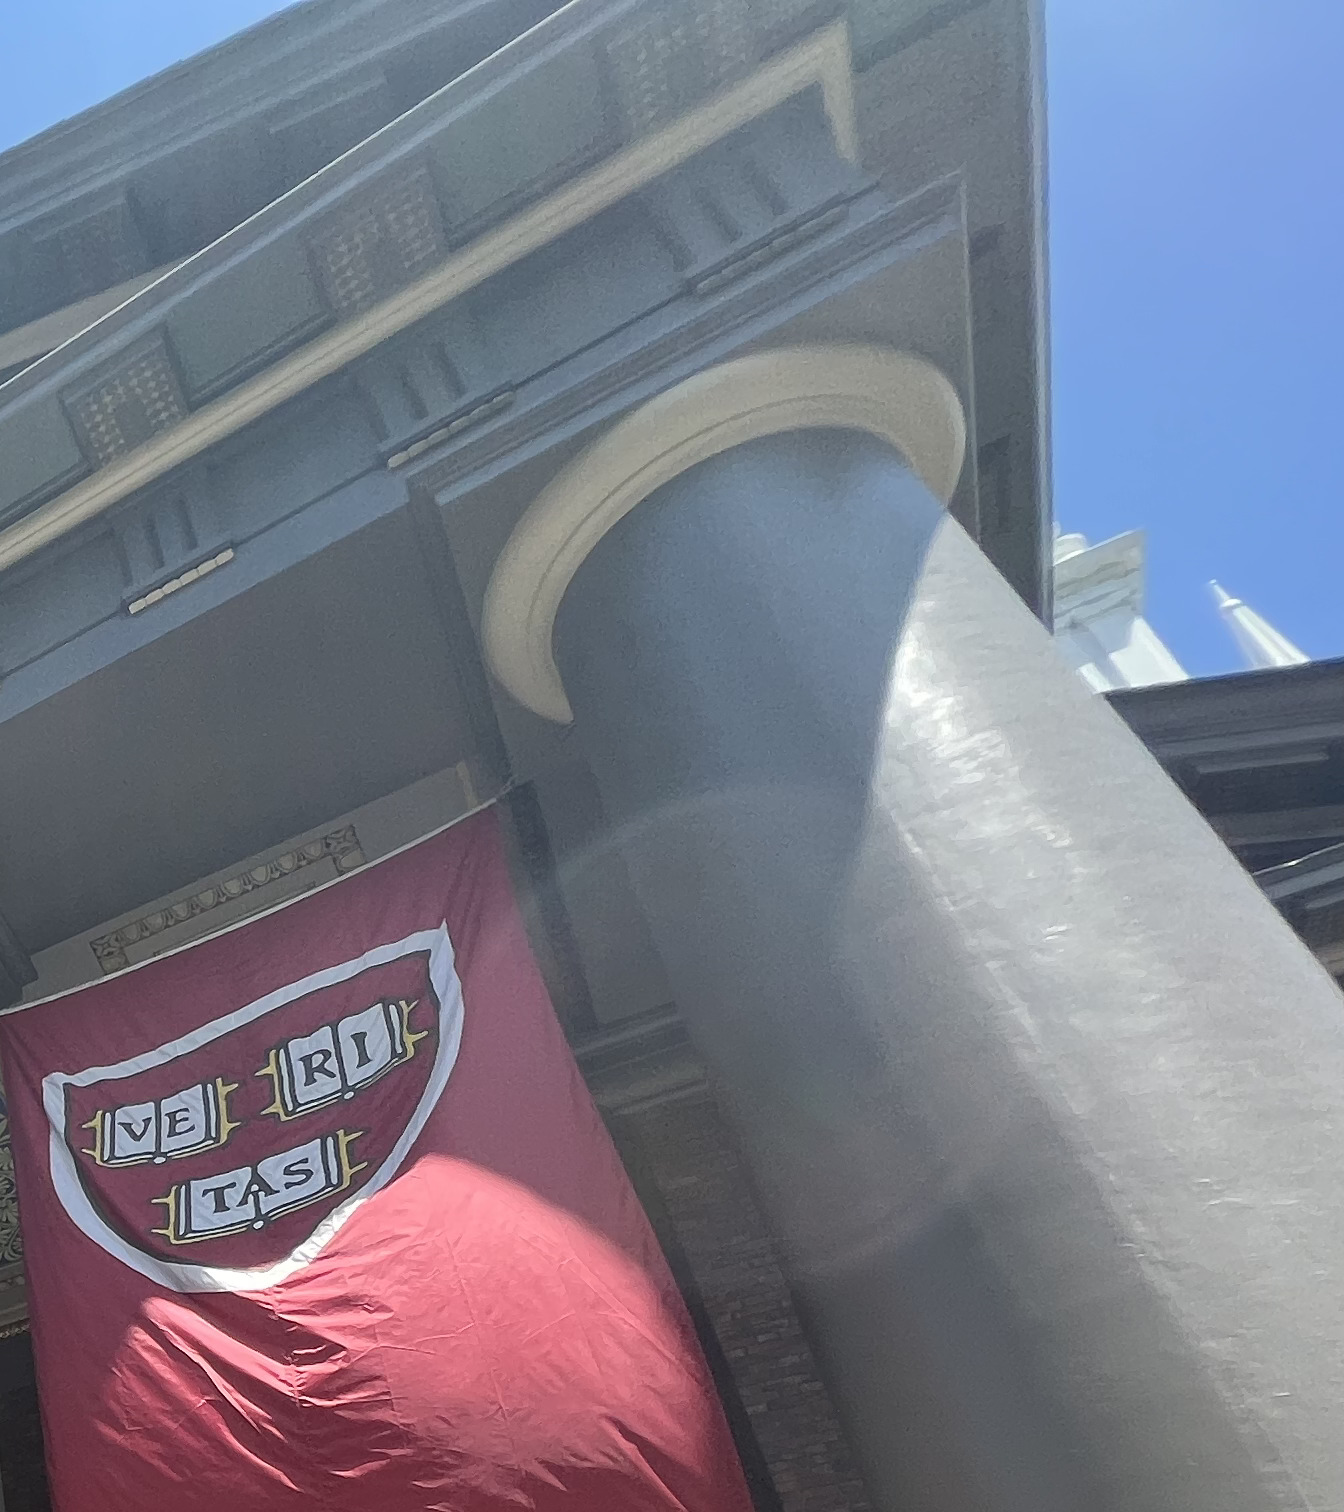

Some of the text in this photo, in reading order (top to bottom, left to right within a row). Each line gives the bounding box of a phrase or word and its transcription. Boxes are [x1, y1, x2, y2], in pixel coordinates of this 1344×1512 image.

[117, 1031, 371, 1142] VE RI
[200, 1155, 314, 1213] TAS
